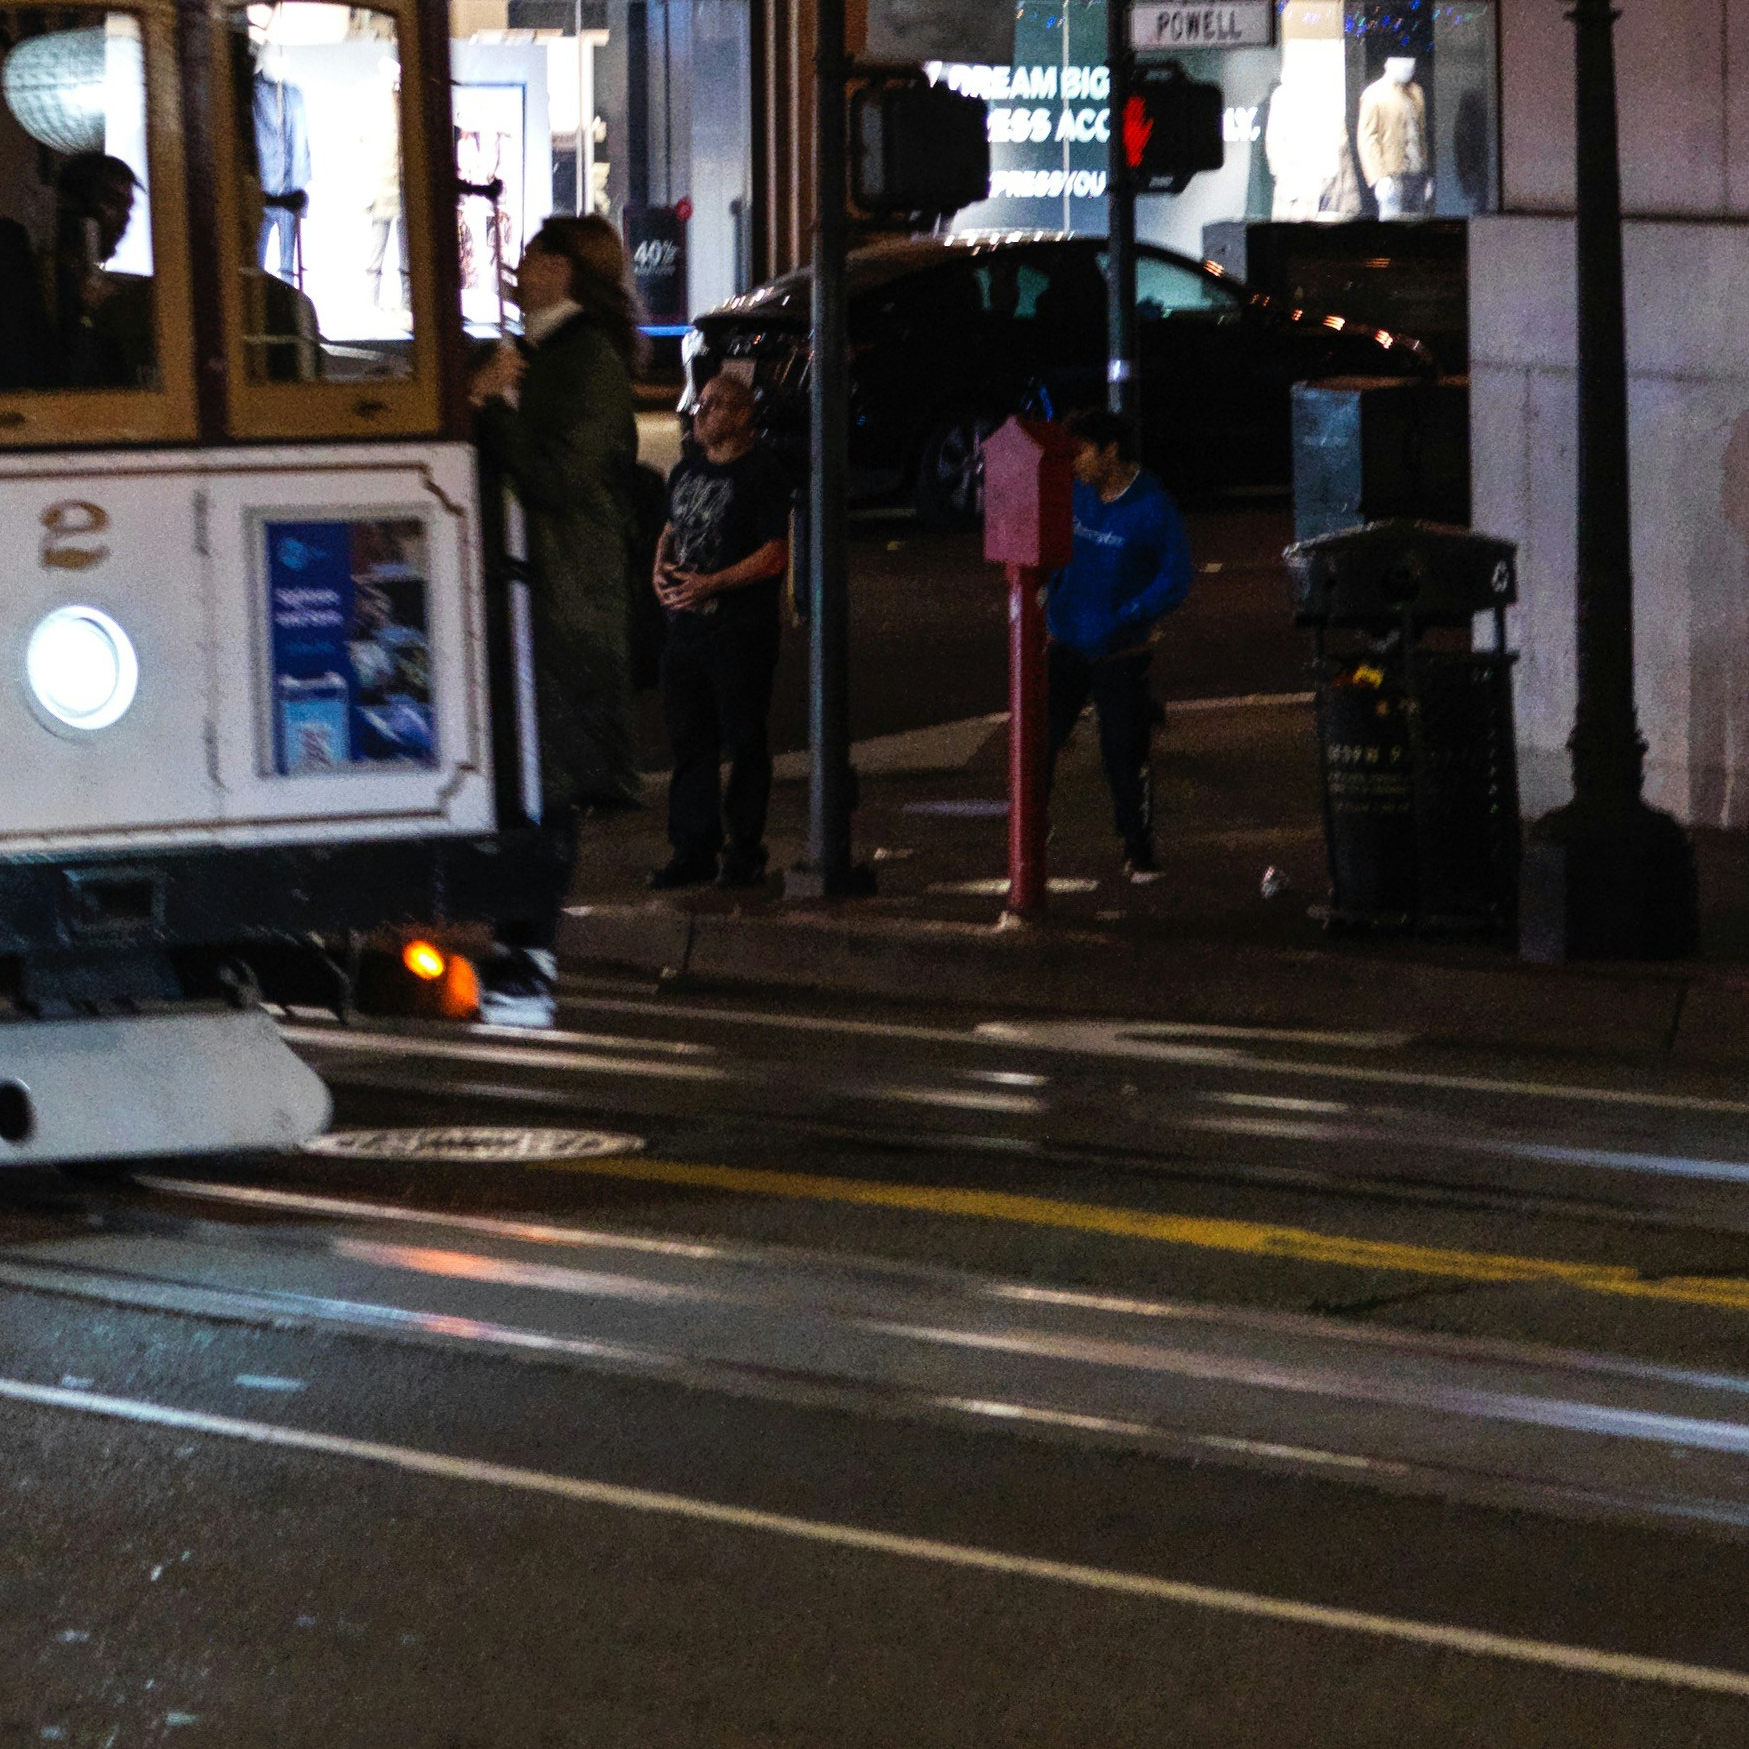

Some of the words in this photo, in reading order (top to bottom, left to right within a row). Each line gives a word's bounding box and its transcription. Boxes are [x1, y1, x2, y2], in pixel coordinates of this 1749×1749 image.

[1156, 10, 1242, 42] POWELL
[1060, 65, 1110, 100] BIG
[987, 107, 1052, 143] ESS
[39, 499, 111, 572] 2
